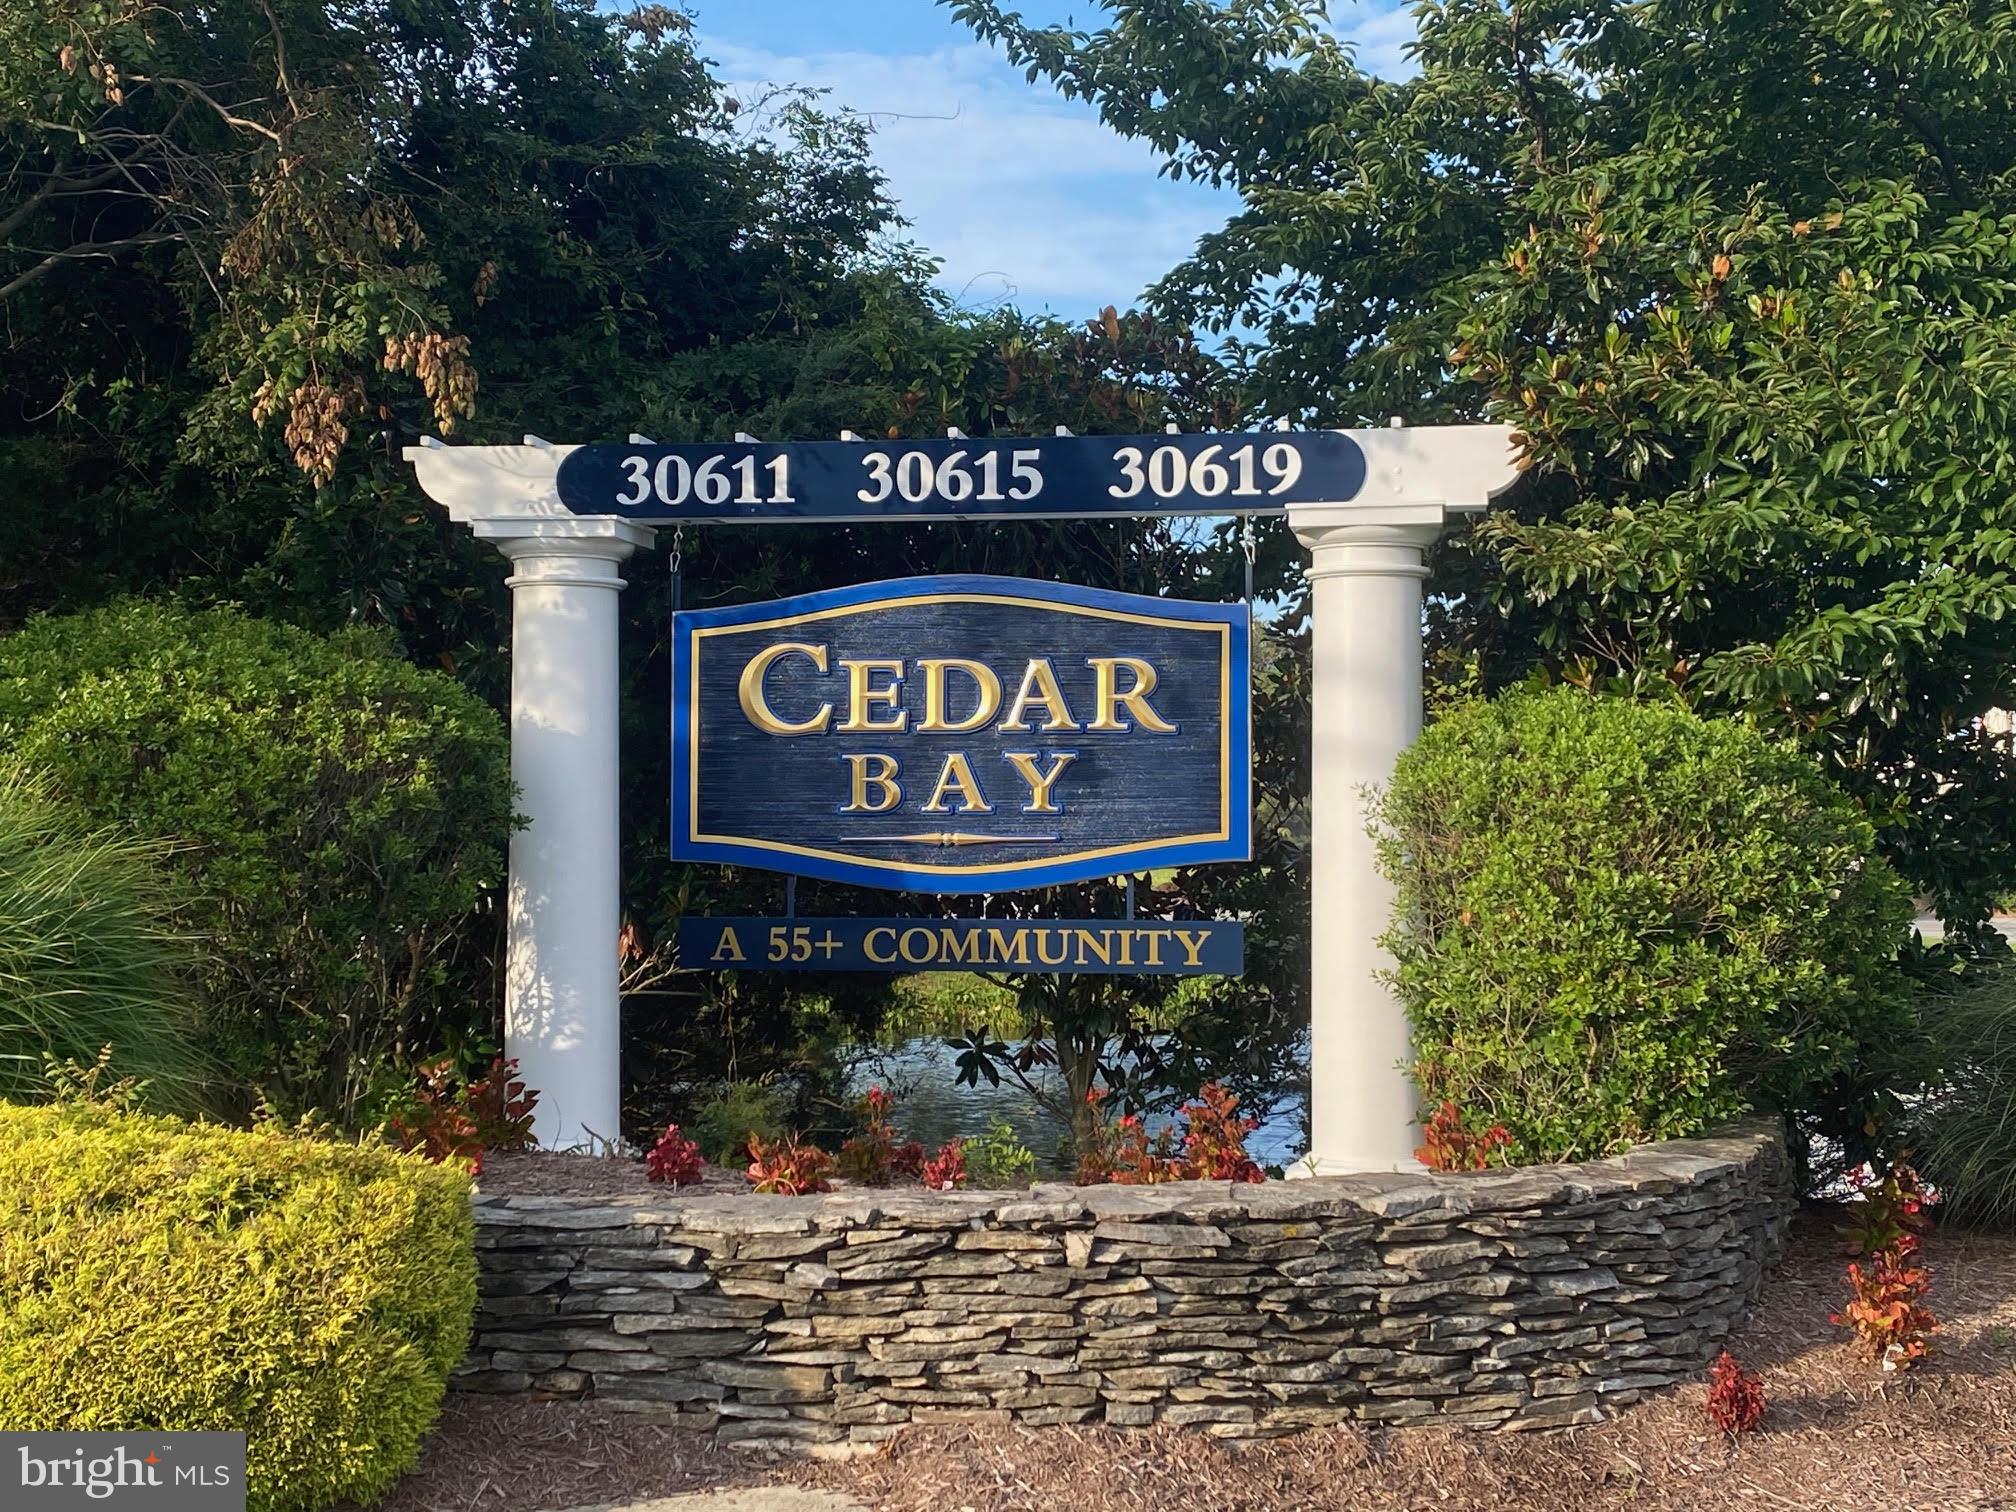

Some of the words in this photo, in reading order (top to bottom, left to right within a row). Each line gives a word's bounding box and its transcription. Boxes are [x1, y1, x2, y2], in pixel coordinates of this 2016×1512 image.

[616, 454, 796, 505] 30611
[856, 448, 1043, 502] 30615
[1108, 443, 1303, 499] 30619
[738, 642, 1180, 736] CEDAR
[840, 753, 1078, 814] BAY
[711, 926, 745, 962] A
[768, 926, 843, 963] 55+
[863, 926, 1212, 967] COMMUNITY
